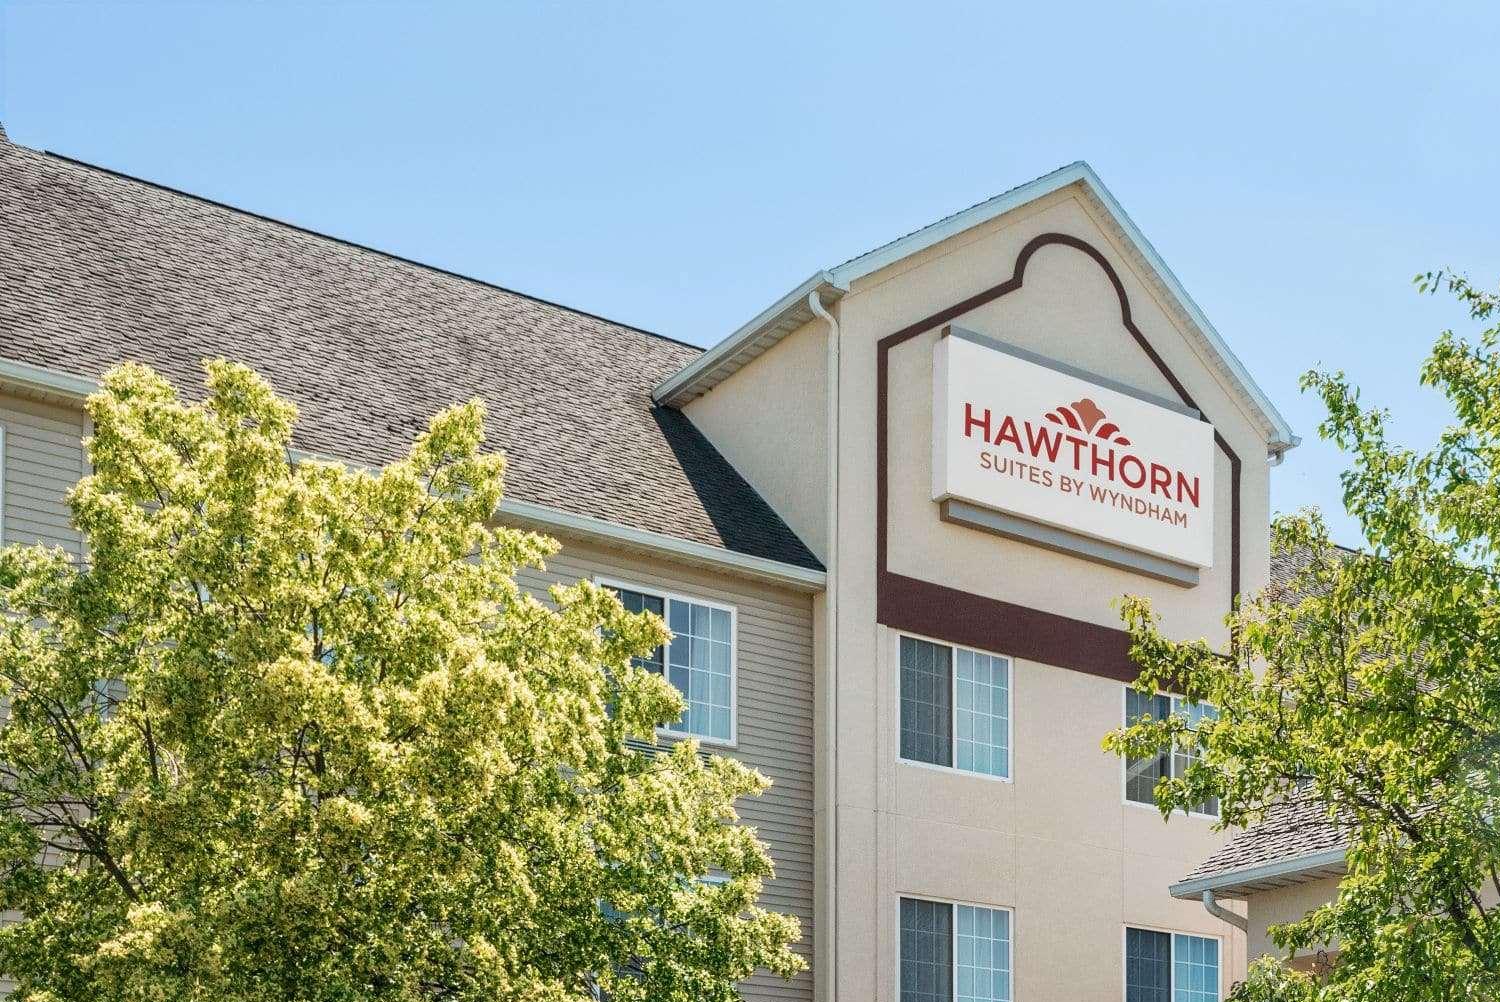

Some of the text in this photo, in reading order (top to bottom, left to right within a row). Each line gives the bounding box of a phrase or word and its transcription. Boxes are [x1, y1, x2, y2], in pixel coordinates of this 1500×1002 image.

[965, 402, 1200, 508] HAWTHORN
[980, 451, 1188, 529] SUITES BY WYNDHAM
